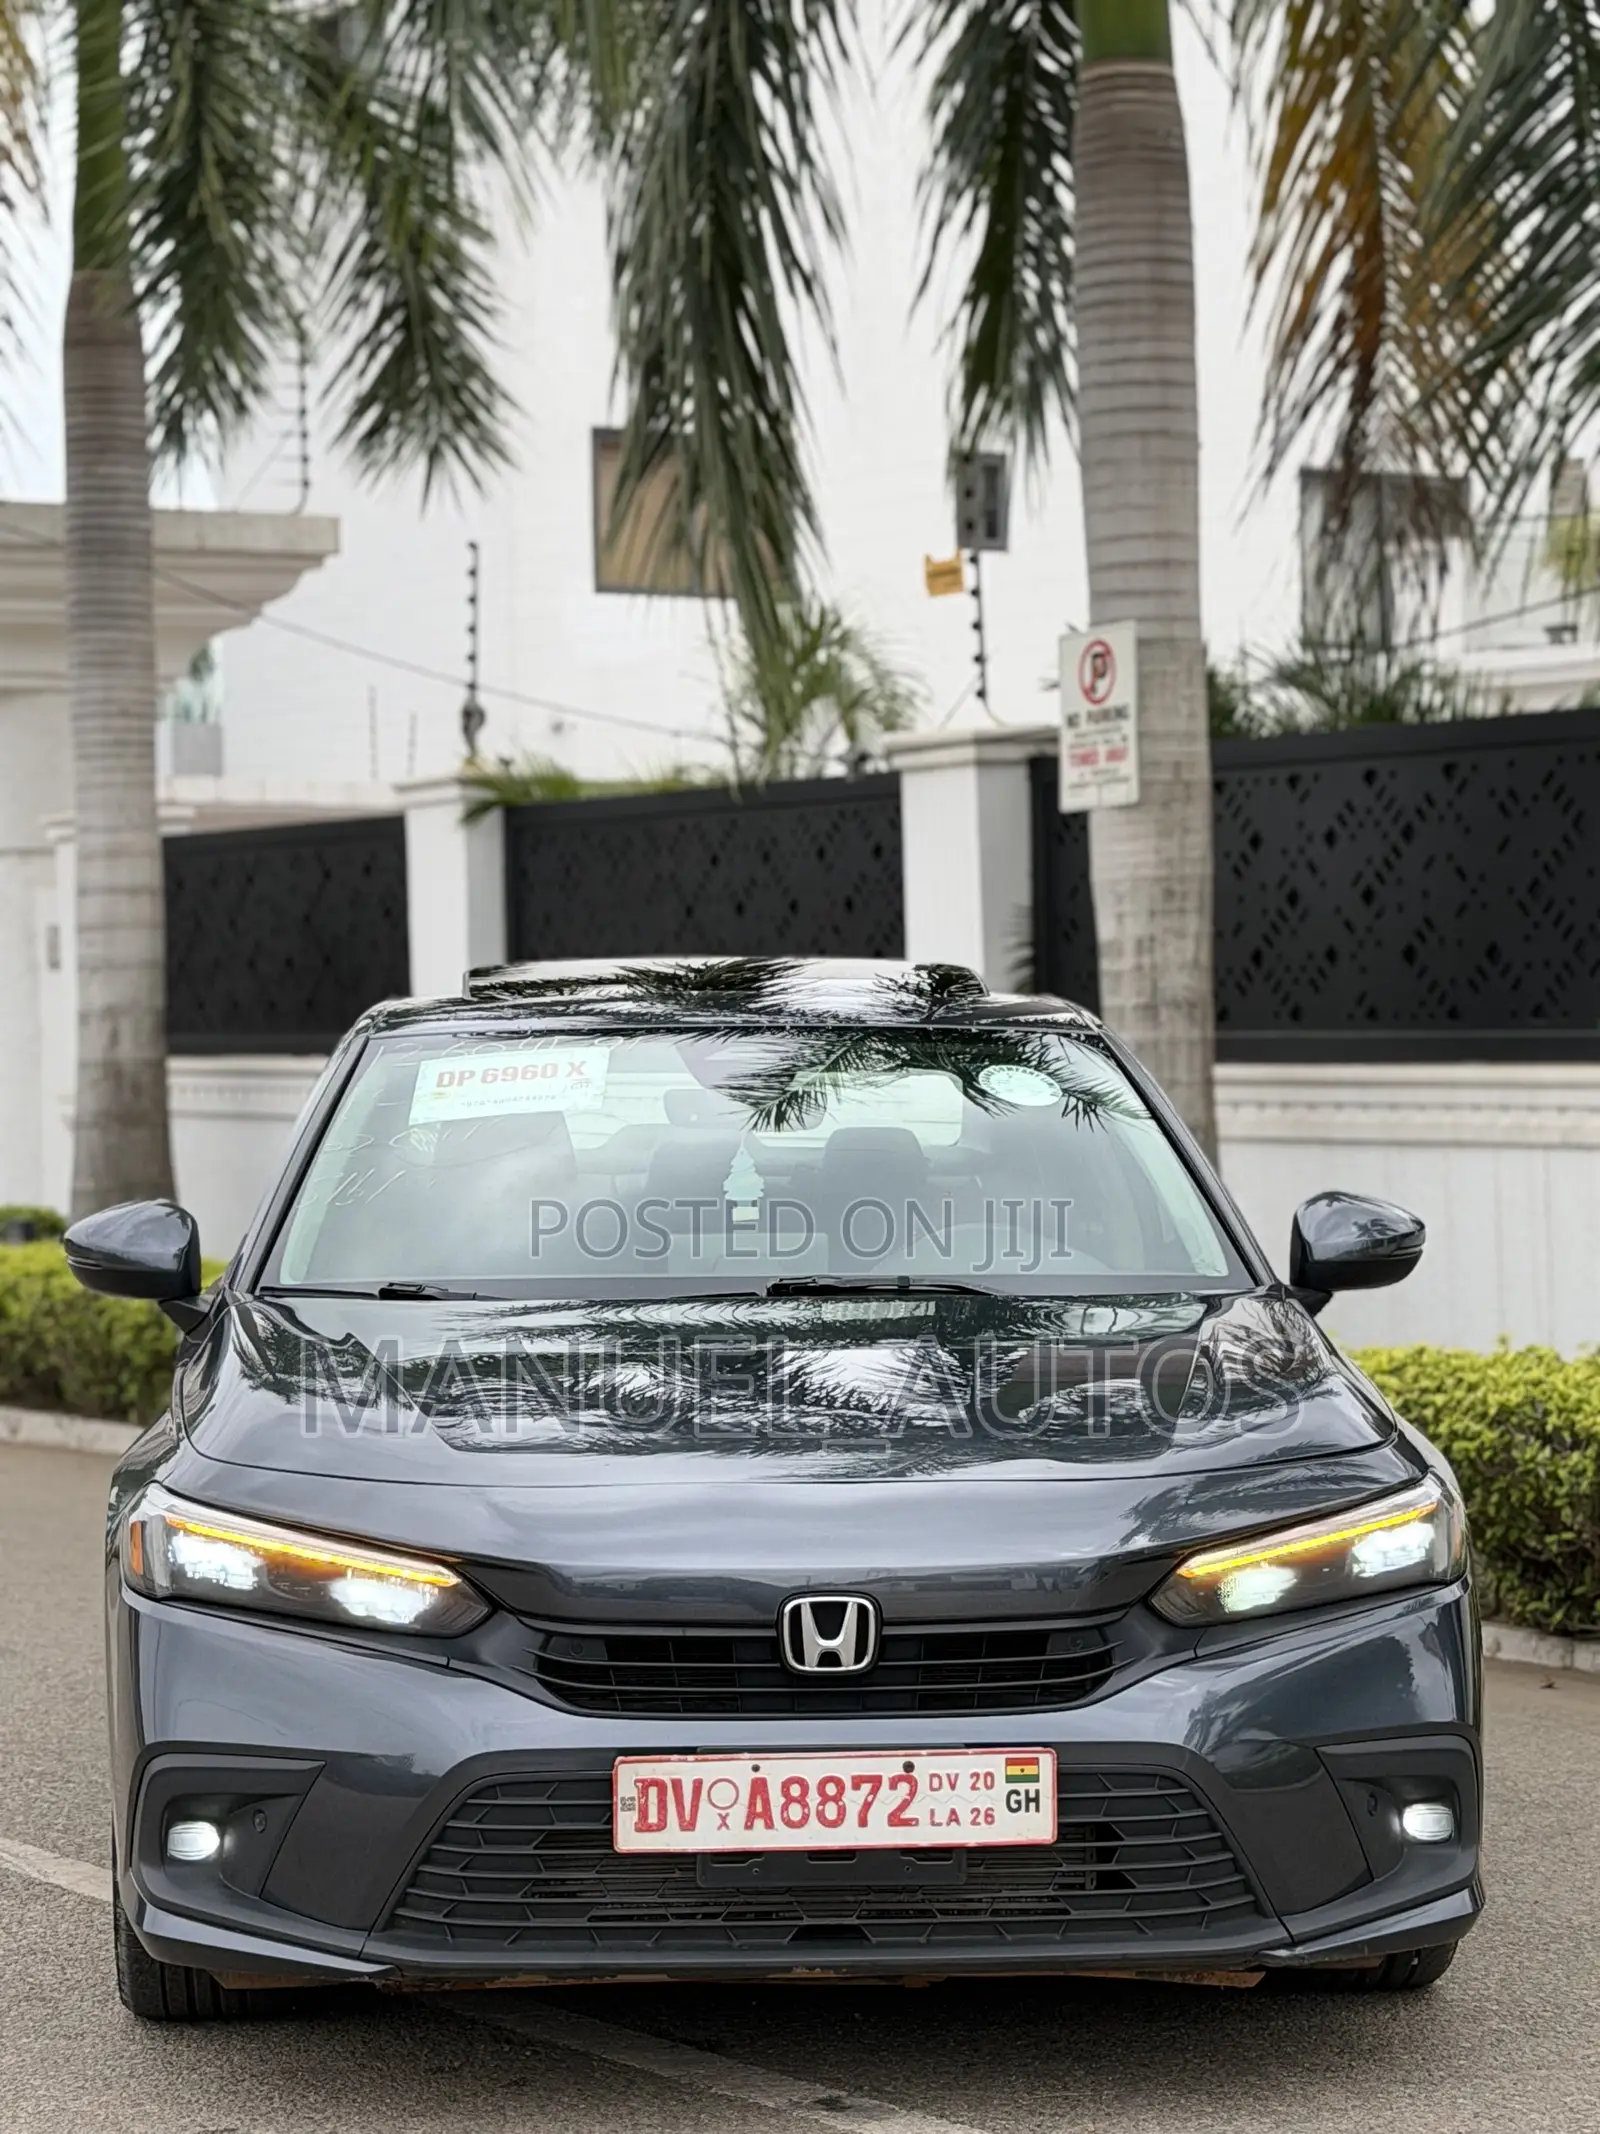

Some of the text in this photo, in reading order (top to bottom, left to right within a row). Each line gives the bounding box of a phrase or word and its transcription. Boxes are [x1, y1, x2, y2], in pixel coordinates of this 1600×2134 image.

[436, 1060, 588, 1088] DP 6960 X
[928, 1771, 996, 1792] DV 20
[634, 1777, 703, 1833] DV
[744, 1773, 919, 1832] A8872
[1005, 1788, 1041, 1814] GH
[929, 1807, 996, 1827] LA 26
